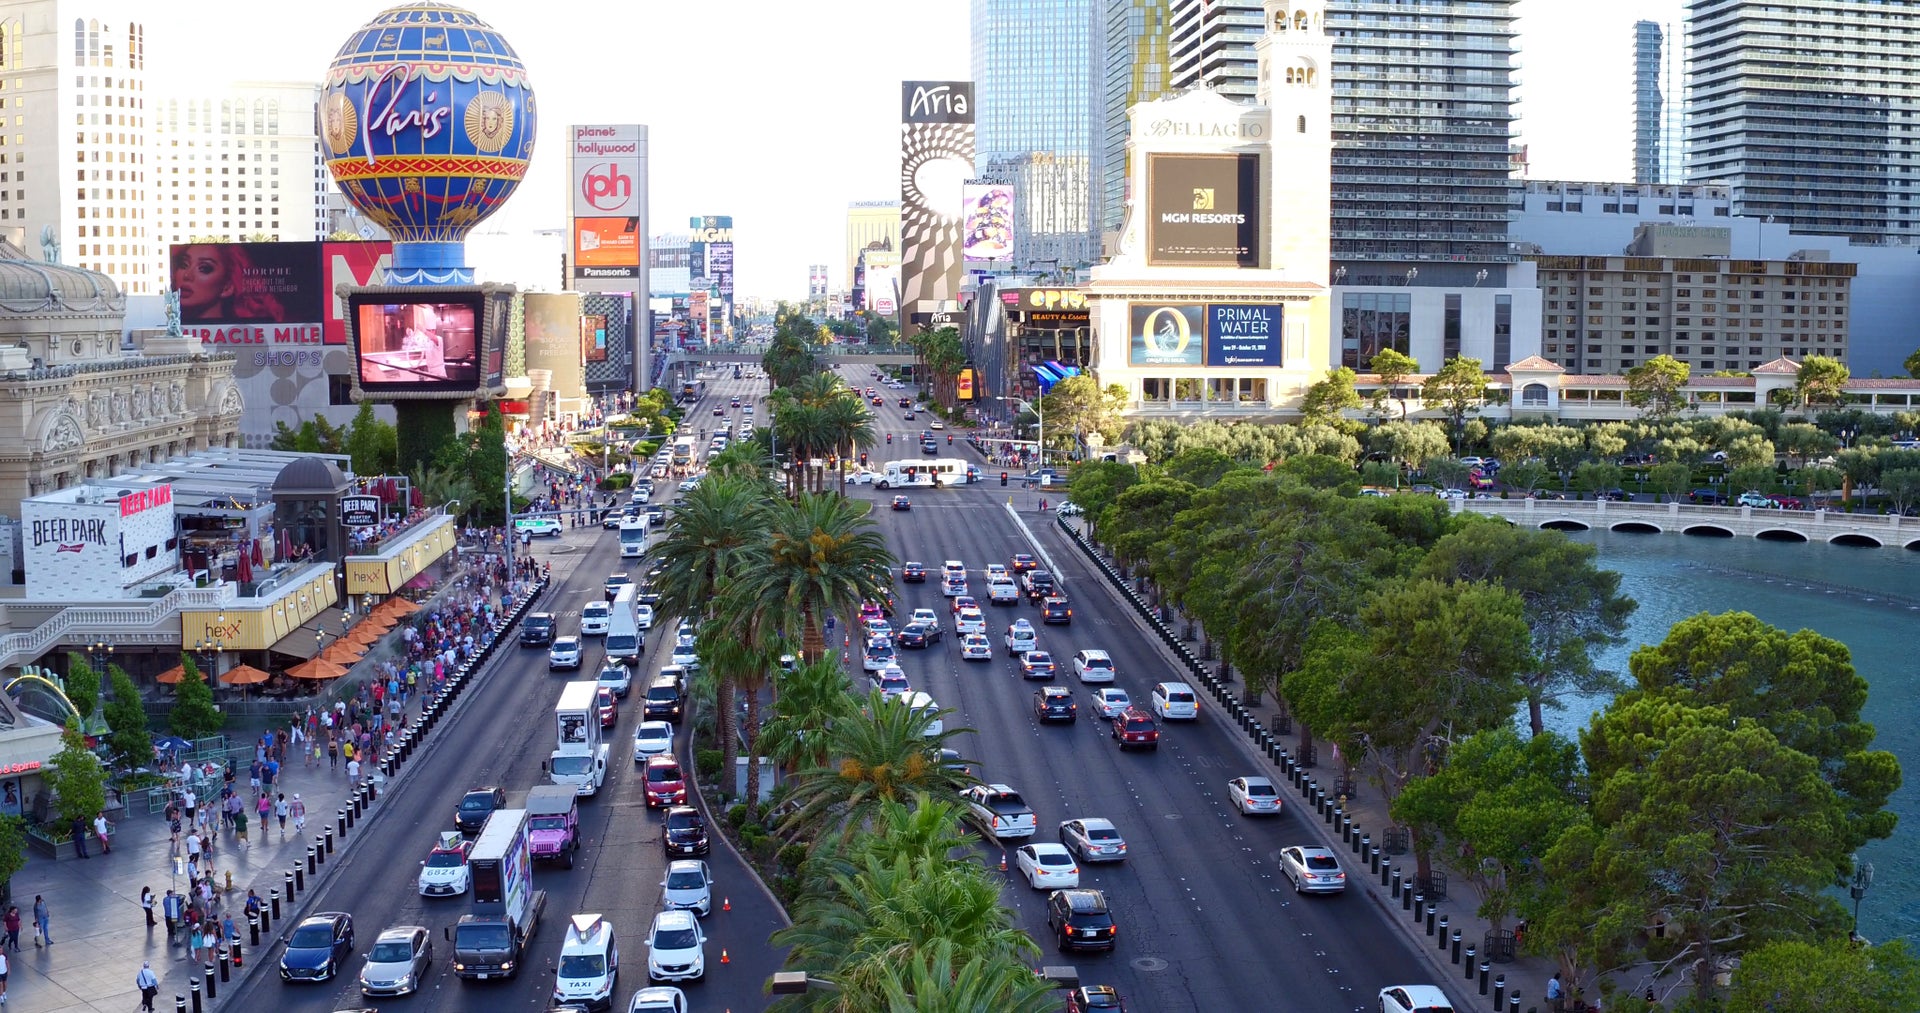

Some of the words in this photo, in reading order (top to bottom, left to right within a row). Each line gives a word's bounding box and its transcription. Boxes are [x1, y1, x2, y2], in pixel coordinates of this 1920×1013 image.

[910, 86, 968, 117] Aria
[363, 62, 451, 166] Paris
[577, 126, 616, 139] planet
[1144, 119, 1263, 138] BELLAGIO
[577, 142, 636, 156] hollywood
[588, 163, 632, 207] ph
[1162, 213, 1190, 223] MGM
[1192, 214, 1246, 224] RESORTS
[689, 227, 734, 243] MGM
[243, 267, 293, 276] MORPHE
[584, 268, 631, 277] Panasonic
[1030, 291, 1090, 309] OPIU
[931, 312, 951, 323] Aria
[1218, 309, 1271, 321] PRIMAL
[1220, 322, 1269, 333] WATER
[274, 327, 320, 343] MILE
[254, 351, 321, 366] SHOPS
[119, 491, 147, 518] BEER
[147, 483, 172, 509] PARK
[344, 500, 360, 513] BEER
[360, 500, 377, 512] PARK
[33, 519, 68, 547] BEER
[72, 519, 107, 546] PARK
[354, 569, 379, 583] hexx
[205, 620, 241, 639] hexx
[3, 764, 10, 774] &
[11, 761, 41, 773] Spirits
